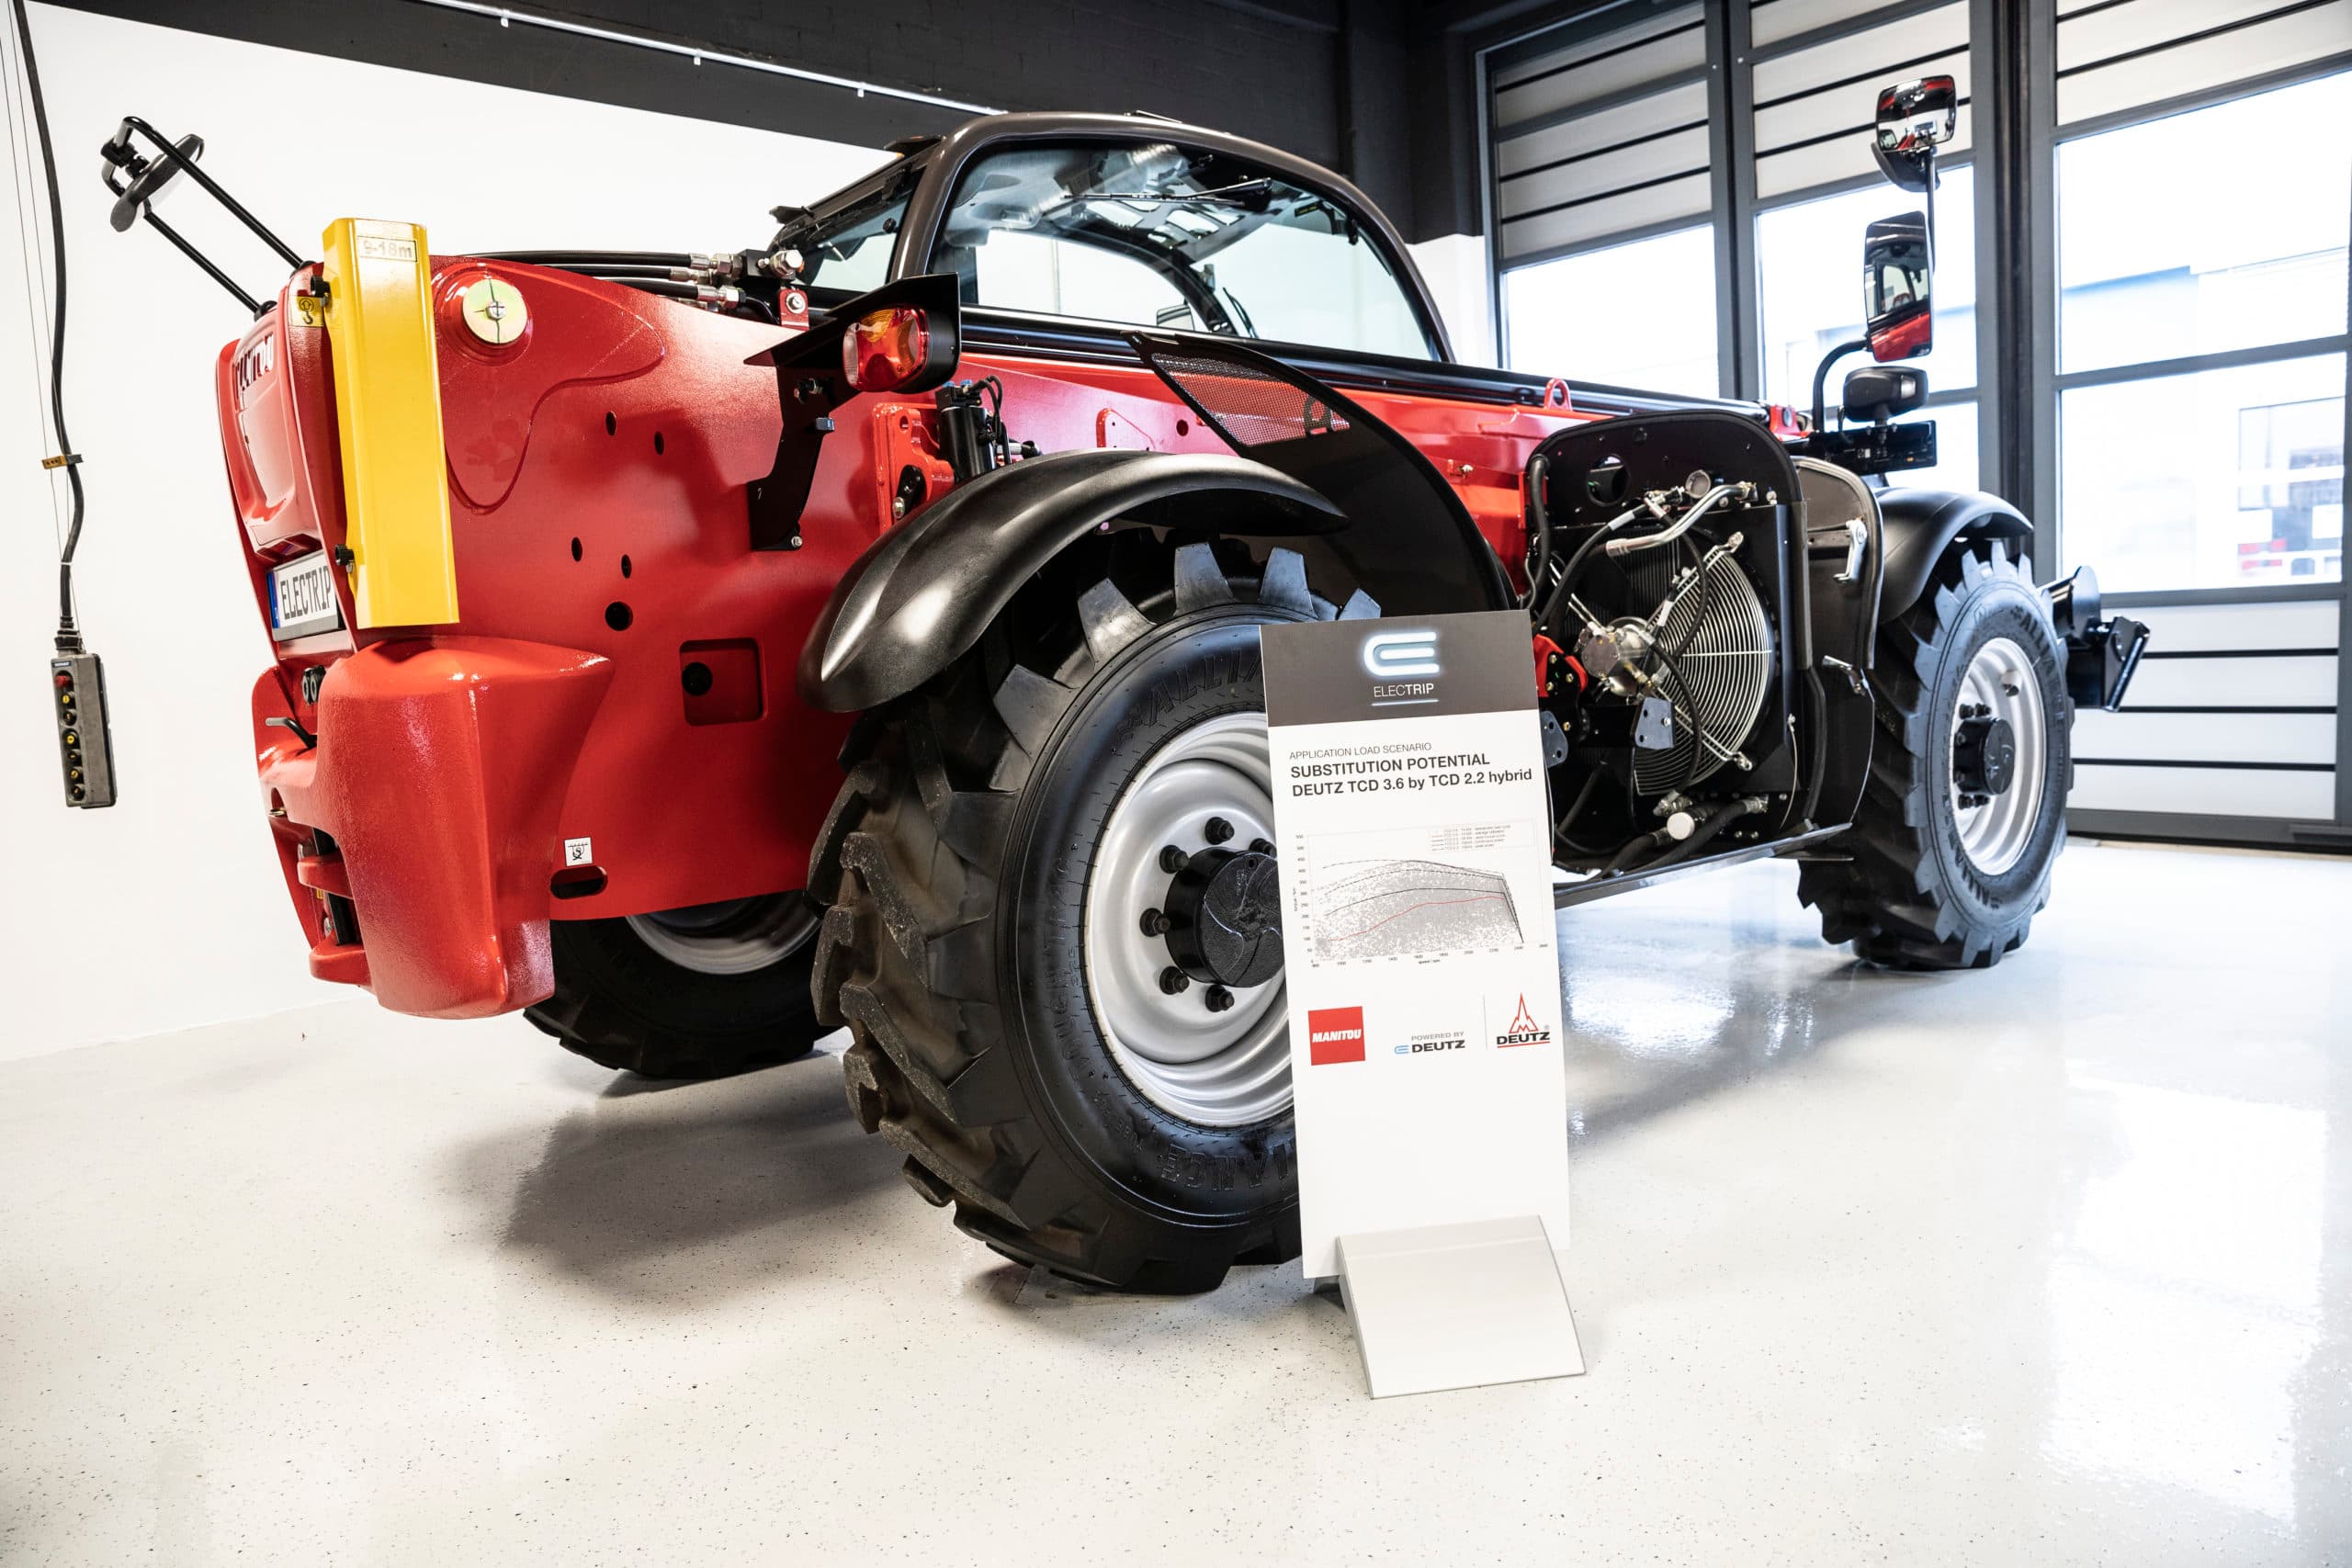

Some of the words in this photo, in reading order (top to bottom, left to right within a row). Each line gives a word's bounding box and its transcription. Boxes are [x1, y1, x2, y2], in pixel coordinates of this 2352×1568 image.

[279, 565, 332, 621] ELECTRIP
[1373, 682, 1435, 698] ELECTRIP
[1289, 748, 1352, 761] APPLICATION
[1354, 745, 1381, 756] LOAD
[1383, 742, 1432, 753] SCENARIO
[1291, 759, 1402, 779] SUBSTITUTION
[1407, 753, 1490, 770] POTENTIAL
[1293, 782, 1344, 796] DEUTZ
[1347, 779, 1379, 793] TCD
[1383, 777, 1405, 790] 3.6
[1408, 777, 1425, 791] by
[1429, 773, 1460, 787] TCD
[1464, 772, 1486, 784] 2.2
[1488, 768, 1532, 785] hybrid
[1311, 1029, 1363, 1043] MANITOU
[1410, 1032, 1452, 1042] POWERED
[1496, 1031, 1551, 1045] DEUTZ
[1411, 1039, 1465, 1053] DEUTZ
